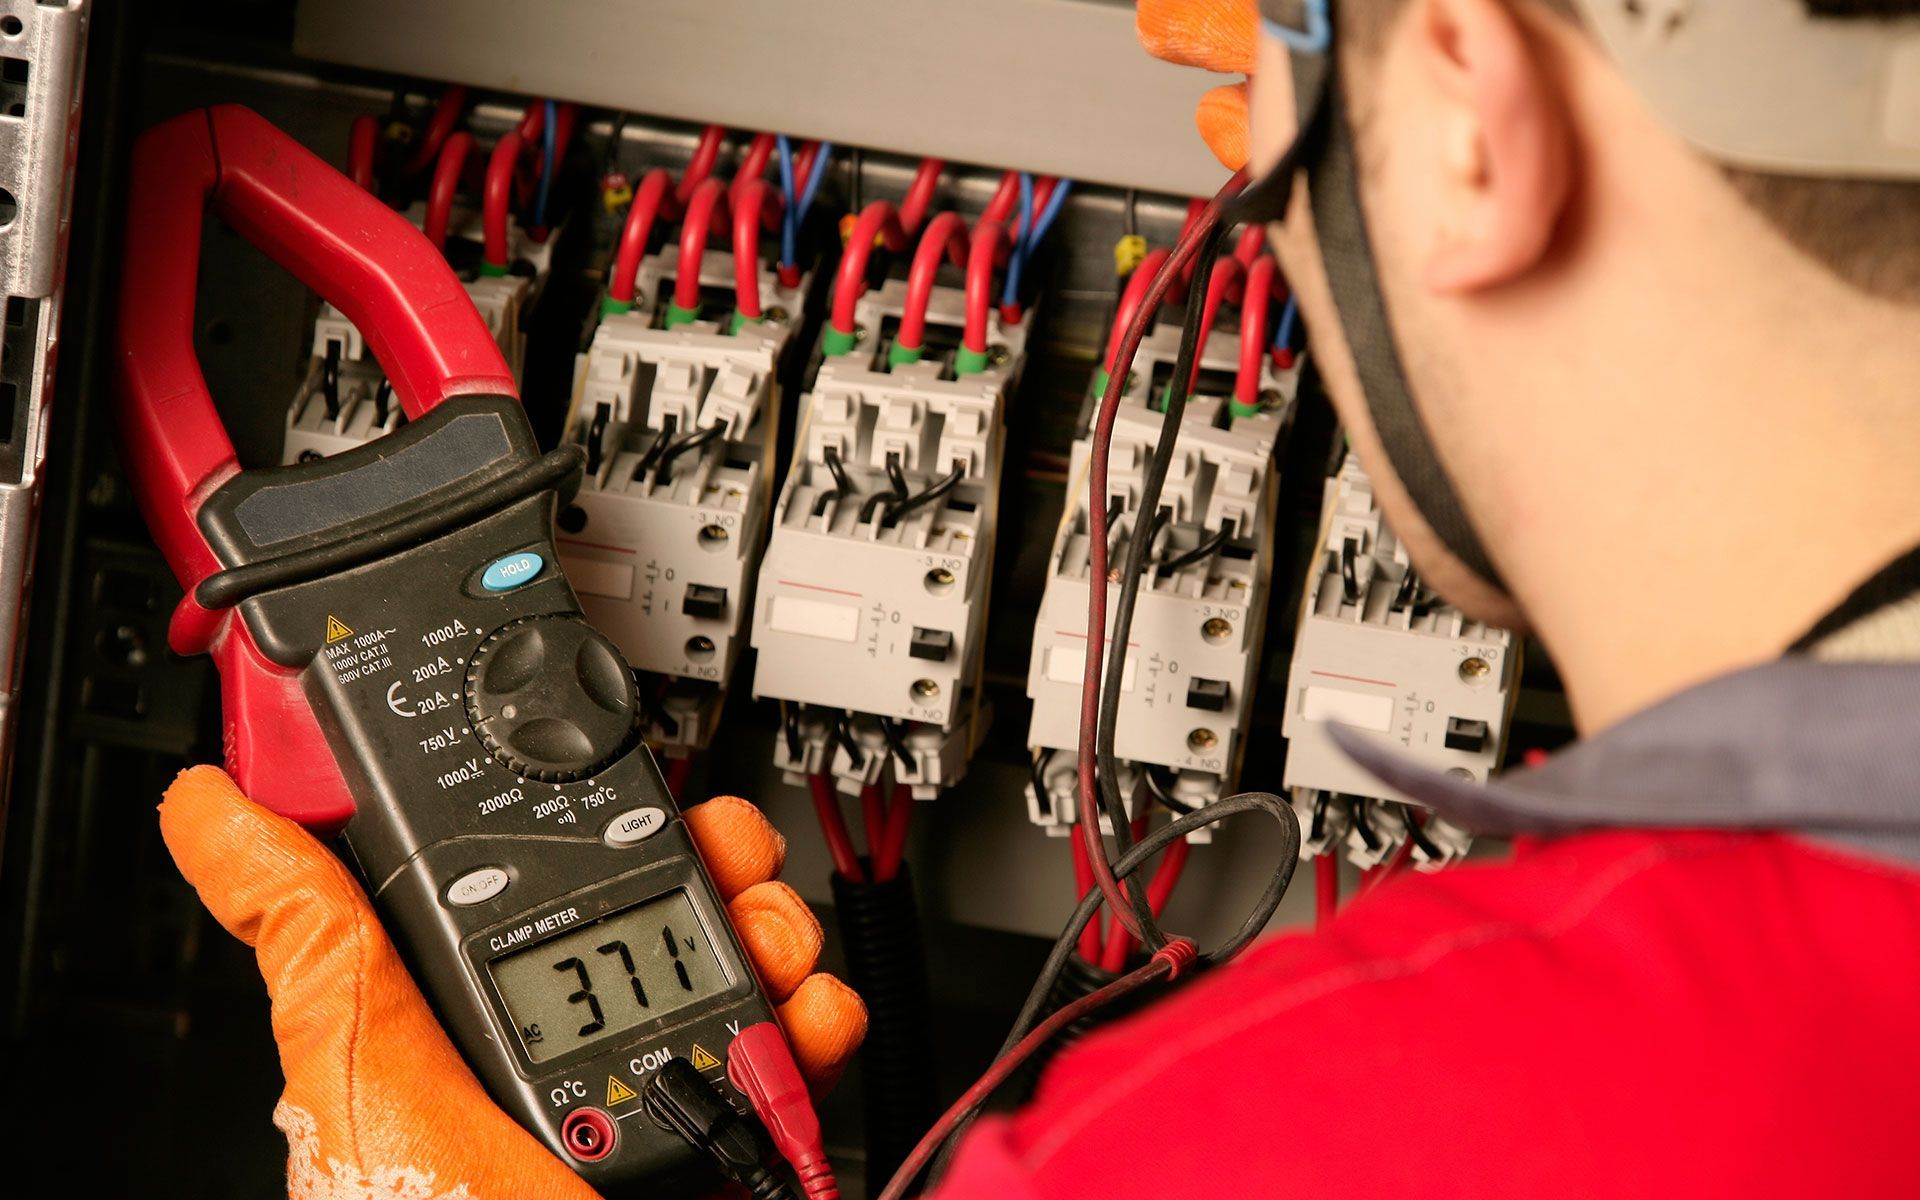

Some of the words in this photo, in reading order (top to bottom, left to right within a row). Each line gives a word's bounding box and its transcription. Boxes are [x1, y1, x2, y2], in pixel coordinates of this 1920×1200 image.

[500, 559, 530, 578] HOLD
[941, 558, 961, 570] NO
[1219, 609, 1239, 621] NO
[325, 642, 351, 660] MAX
[1477, 648, 1498, 660] NO
[332, 654, 359, 672] 1000V
[337, 668, 360, 685] 600V
[621, 814, 653, 833] LIGHT
[489, 924, 533, 952] CLAMP
[535, 907, 580, 934] METER
[553, 925, 693, 1037] 371
[683, 935, 696, 952] V
[629, 1047, 673, 1076] COM
